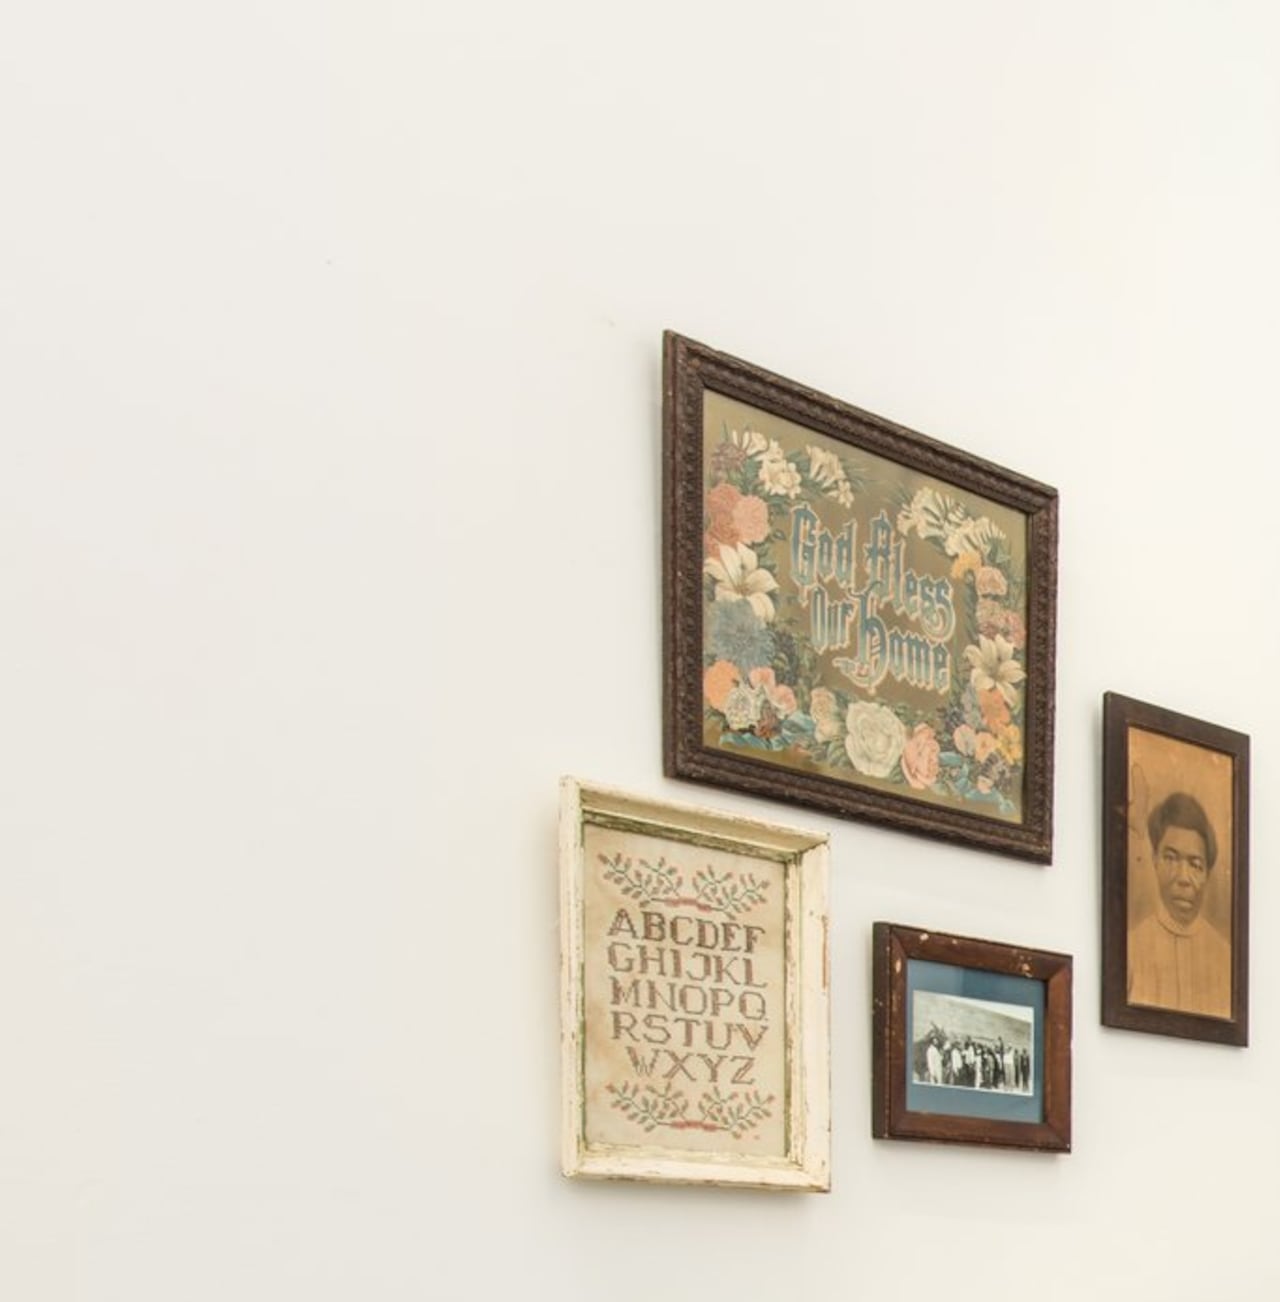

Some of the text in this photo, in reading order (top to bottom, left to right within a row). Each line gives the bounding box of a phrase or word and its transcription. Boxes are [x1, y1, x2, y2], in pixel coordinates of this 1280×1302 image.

[791, 502, 956, 643] God Bless
[811, 580, 951, 696] Our Home
[607, 908, 767, 954] ABCDEF
[607, 941, 768, 989] GHIJKL
[610, 1010, 769, 1051] RSTUV
[625, 1045, 757, 1085] WXYZ
